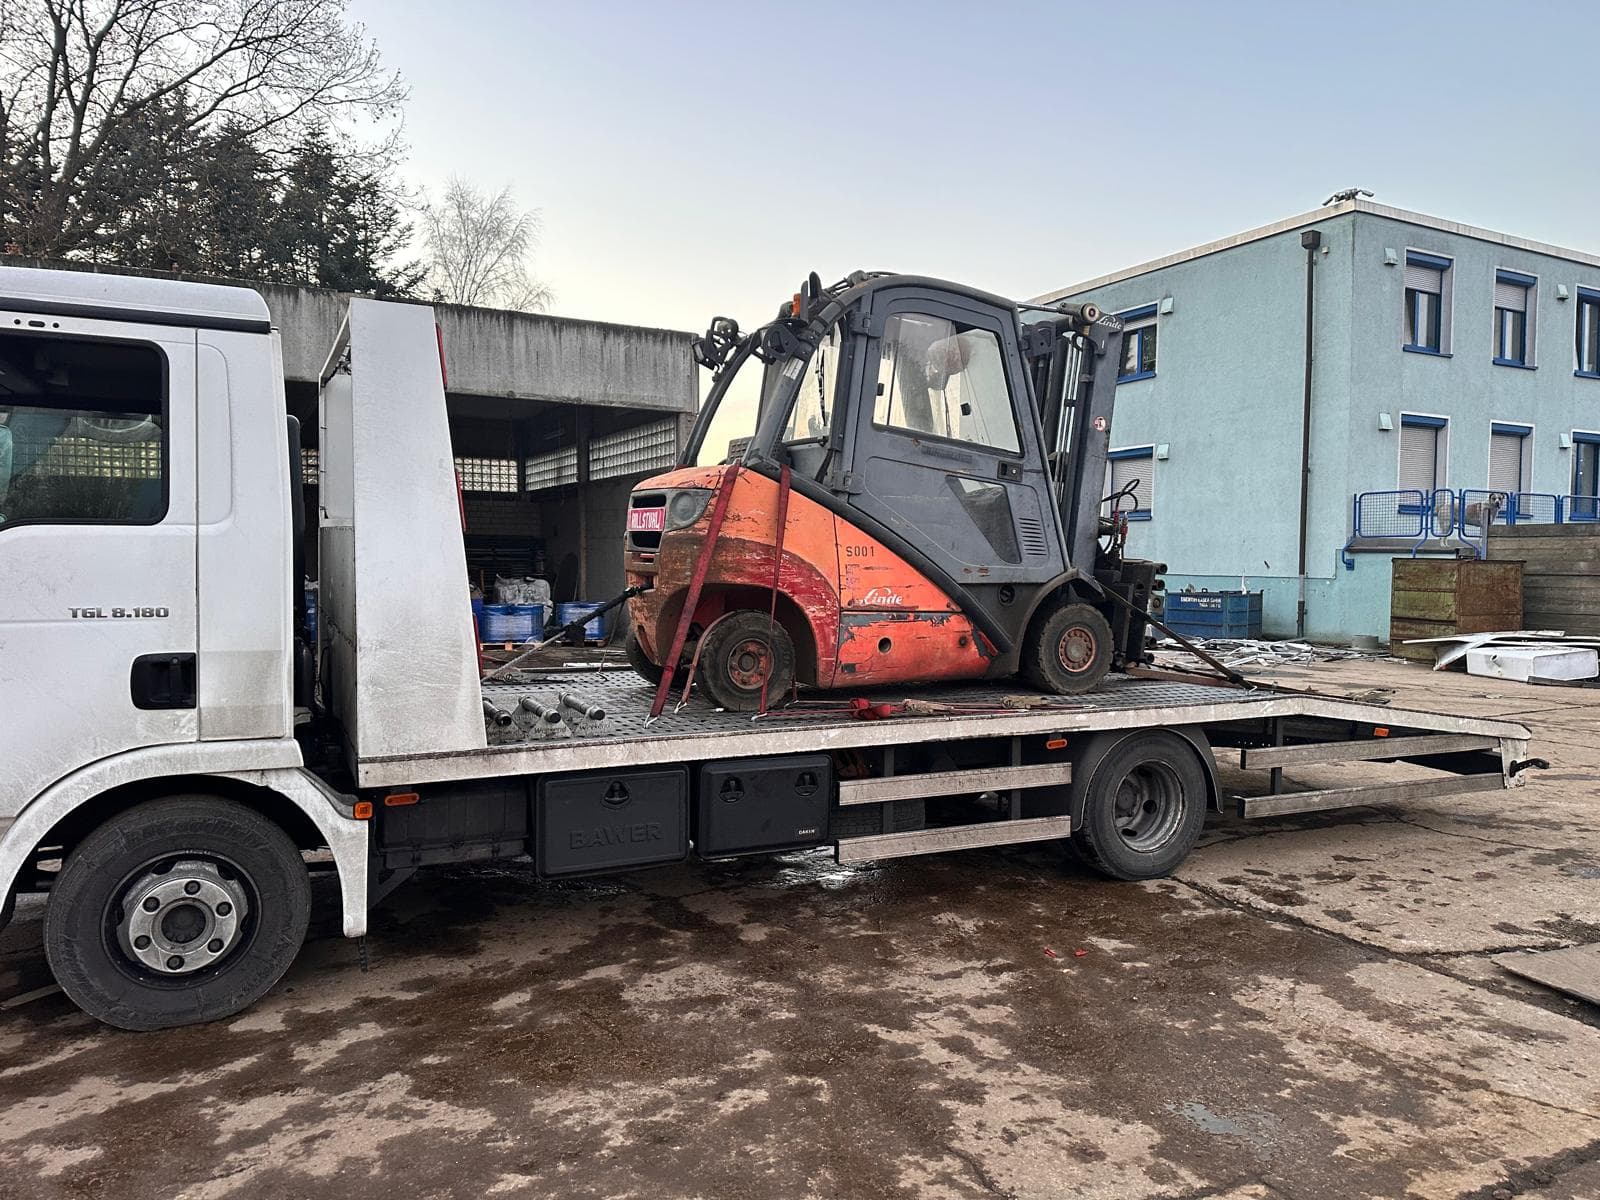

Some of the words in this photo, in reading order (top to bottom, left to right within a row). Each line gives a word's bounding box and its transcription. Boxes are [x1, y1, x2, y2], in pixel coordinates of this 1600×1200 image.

[1096, 315, 1122, 330] Linde
[862, 587, 903, 605] Linde
[68, 607, 107, 619] TGL
[112, 607, 169, 618] 8.180
[569, 823, 662, 850] BAWER
